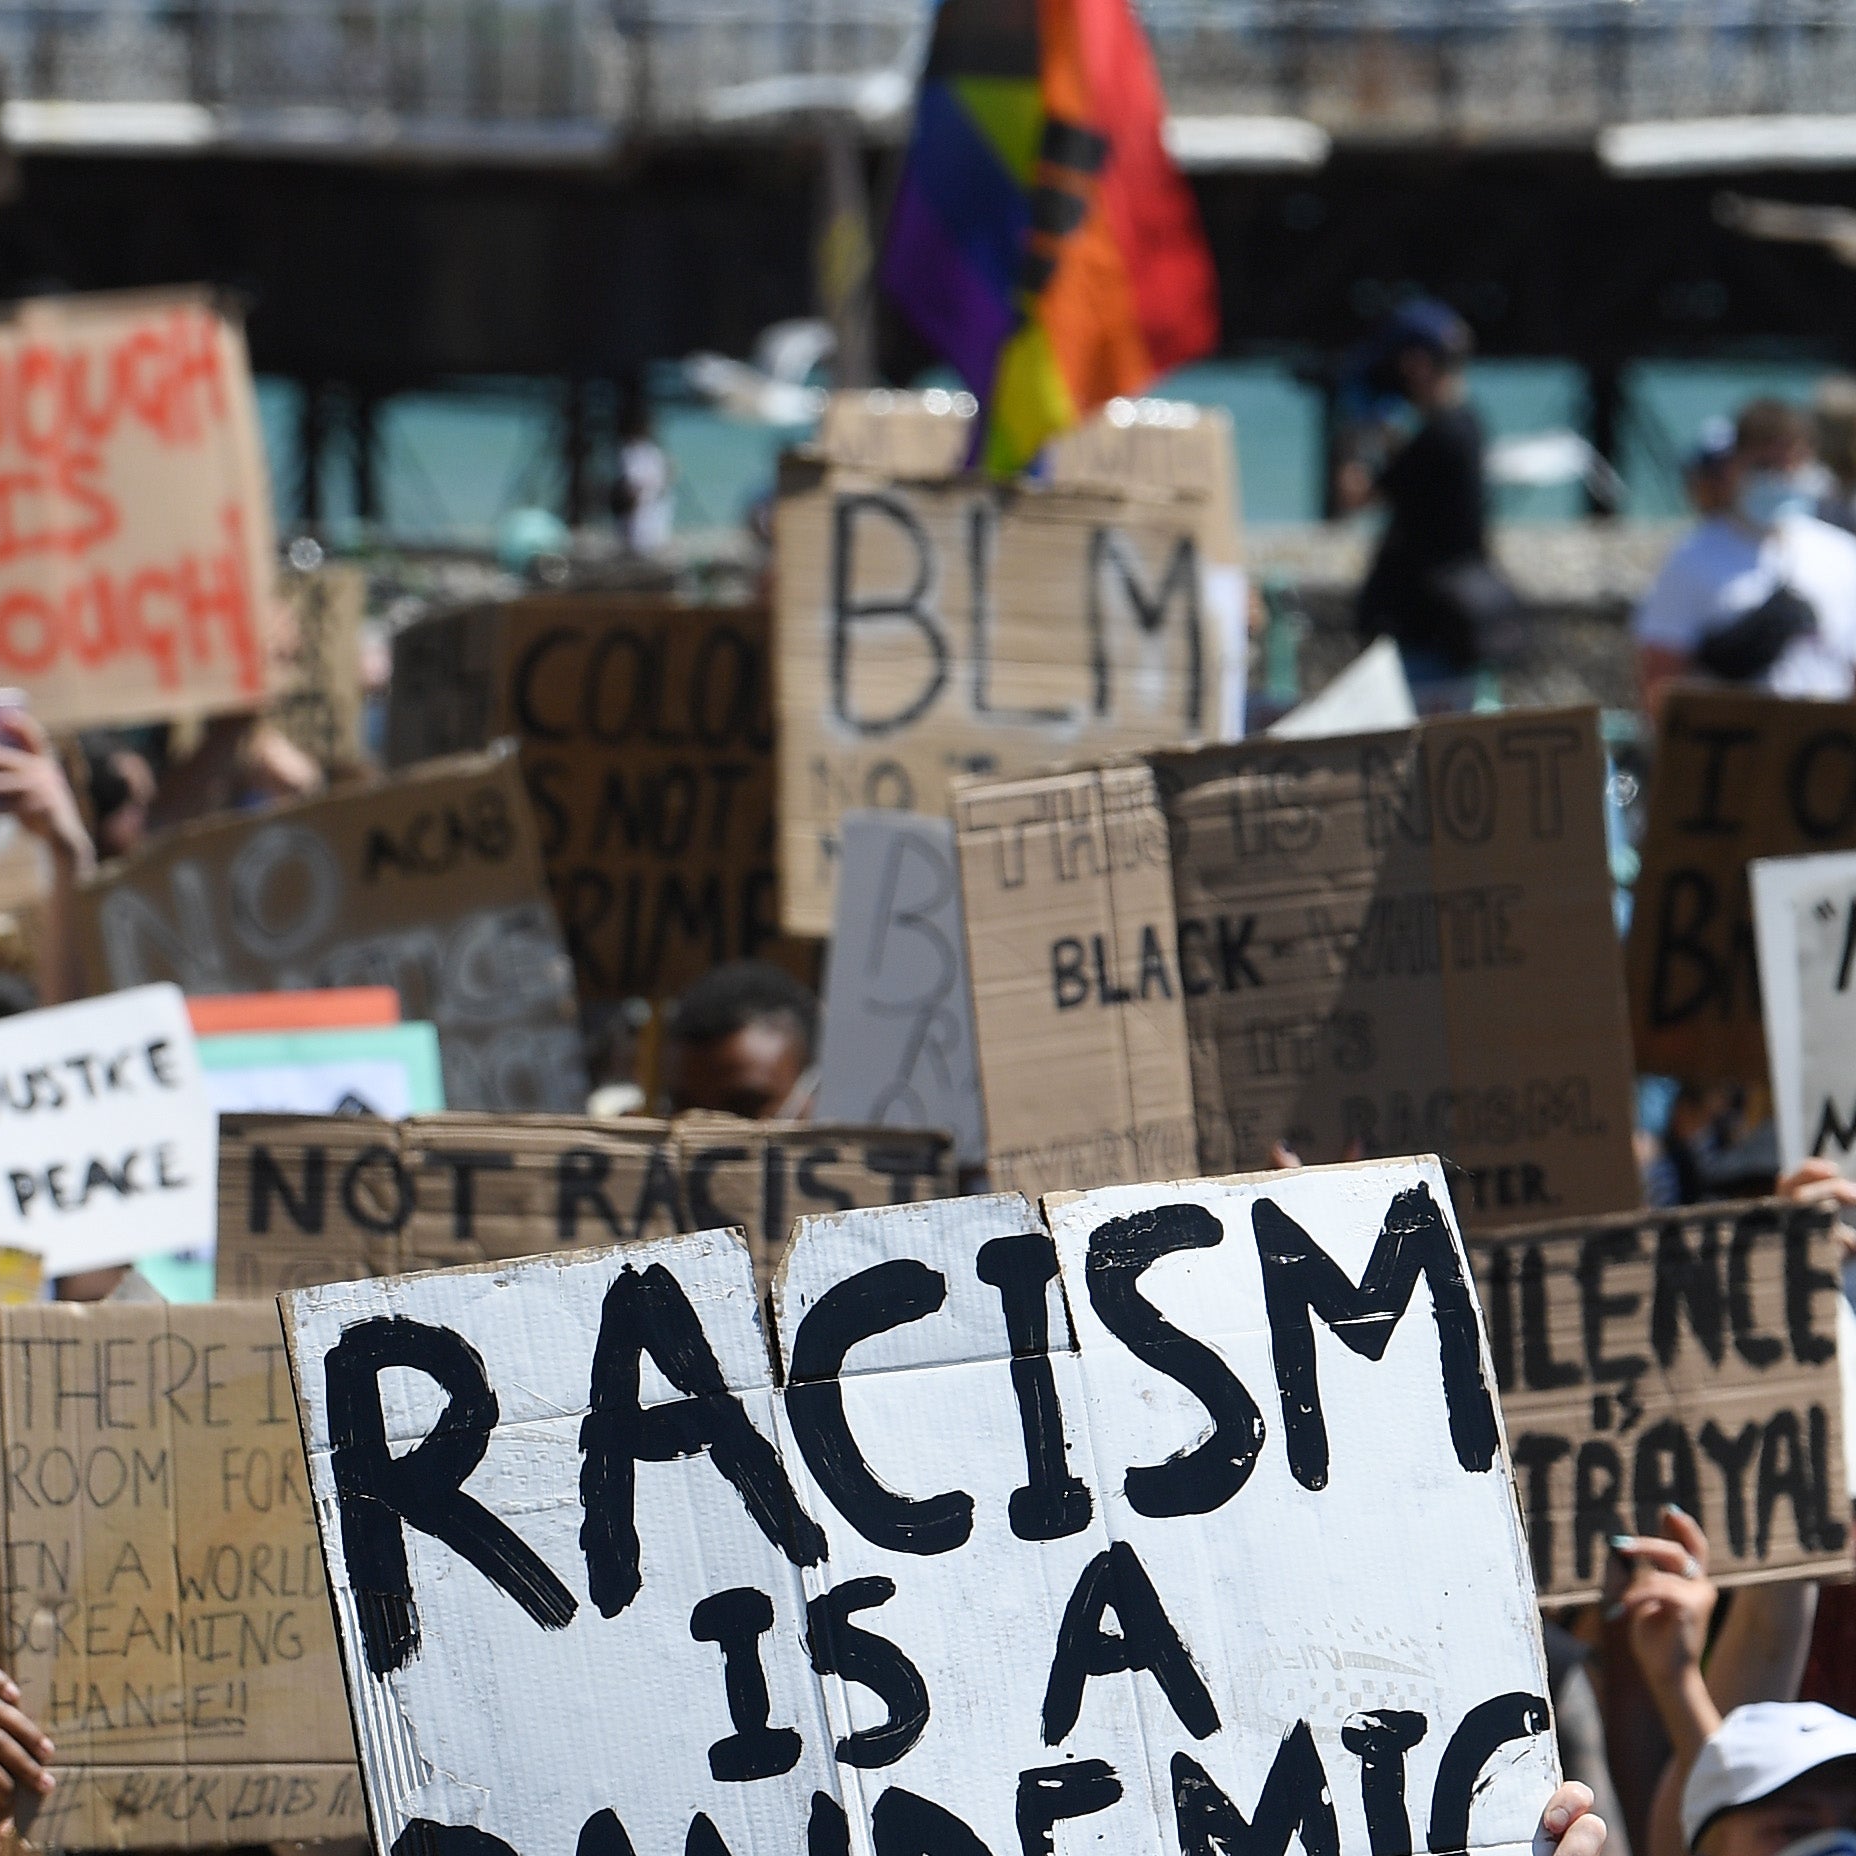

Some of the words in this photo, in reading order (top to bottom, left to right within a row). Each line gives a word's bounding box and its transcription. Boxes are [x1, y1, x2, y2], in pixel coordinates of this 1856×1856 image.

[828, 490, 1204, 740] BLM
[512, 625, 778, 756] COLO
[592, 762, 752, 864] NOT
[1232, 755, 1324, 865] IS
[1357, 724, 1584, 850] NOT
[101, 825, 339, 993] NO
[546, 862, 779, 992] RIME
[1052, 912, 1265, 1011] BLACK
[6, 1140, 190, 1226] PEACE
[248, 1141, 514, 1242] NOT
[552, 1143, 944, 1262] RACIST
[1481, 1206, 1840, 1393] ILENCE
[251, 1344, 291, 1426] I
[323, 1179, 1502, 1678] RACISM
[1590, 1382, 1646, 1433] IS
[4, 1441, 171, 1513] ROOM
[221, 1446, 312, 1514] FOR
[1514, 1404, 1848, 1605] TRAYAL
[0, 1539, 71, 1598] IN
[104, 1541, 152, 1595] A
[175, 1541, 340, 1602] WORLD
[4, 1602, 306, 1666] SCREAMING
[689, 1573, 933, 1784] IS
[1041, 1540, 1222, 1747] A
